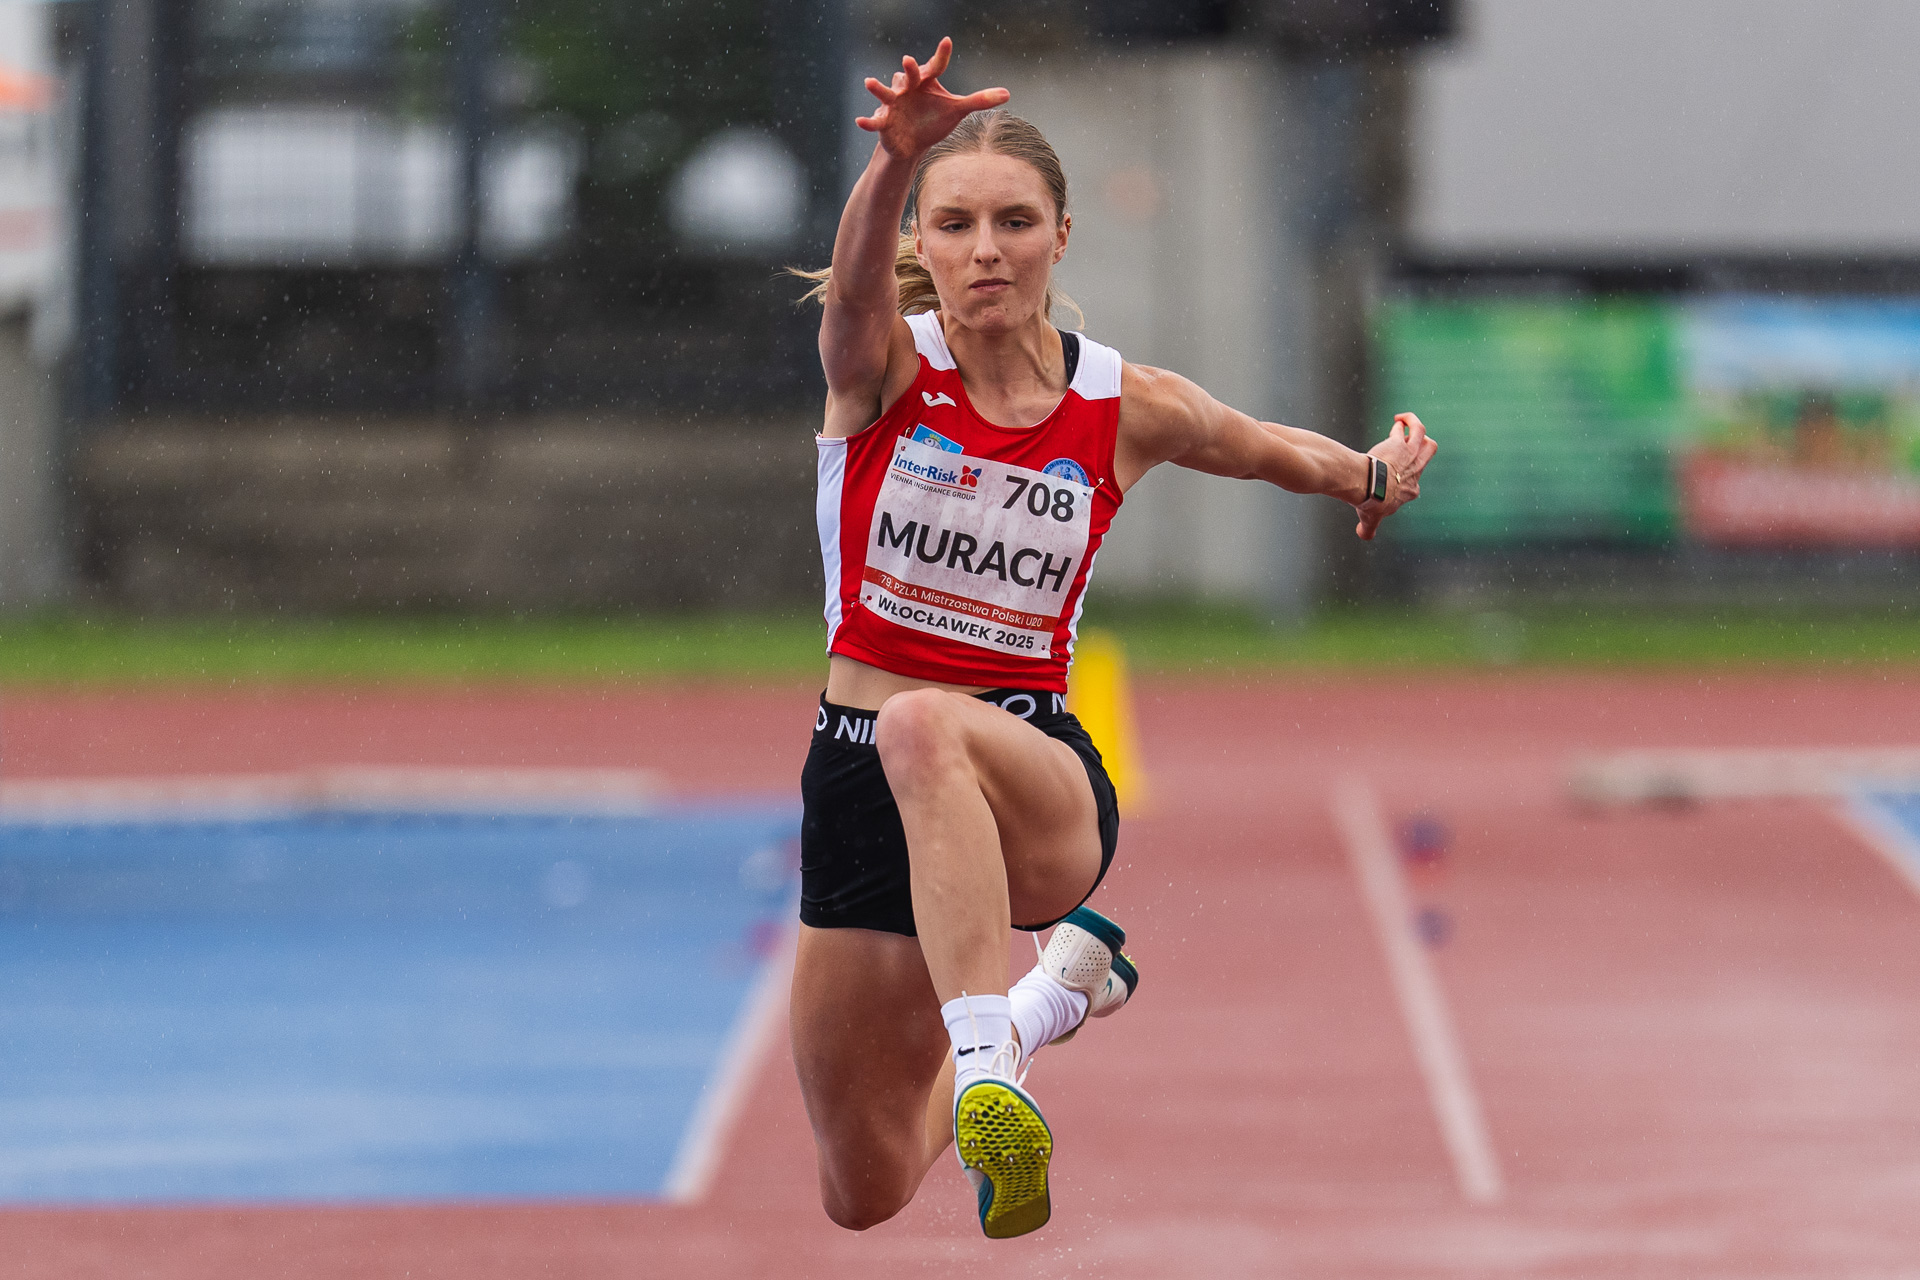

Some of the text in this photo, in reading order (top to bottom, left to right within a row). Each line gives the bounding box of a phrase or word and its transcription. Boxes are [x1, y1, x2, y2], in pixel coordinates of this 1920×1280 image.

[890, 472, 976, 501] VIENNA INSURANCE GROUP
[893, 454, 959, 484] InterRisk
[1002, 474, 1075, 523] 708
[877, 511, 1072, 593] MURACH
[878, 594, 1035, 650] WŁOCŁAWEK 2025
[880, 574, 1043, 628] 79. PZLA Mistrzostwa Polski U20
